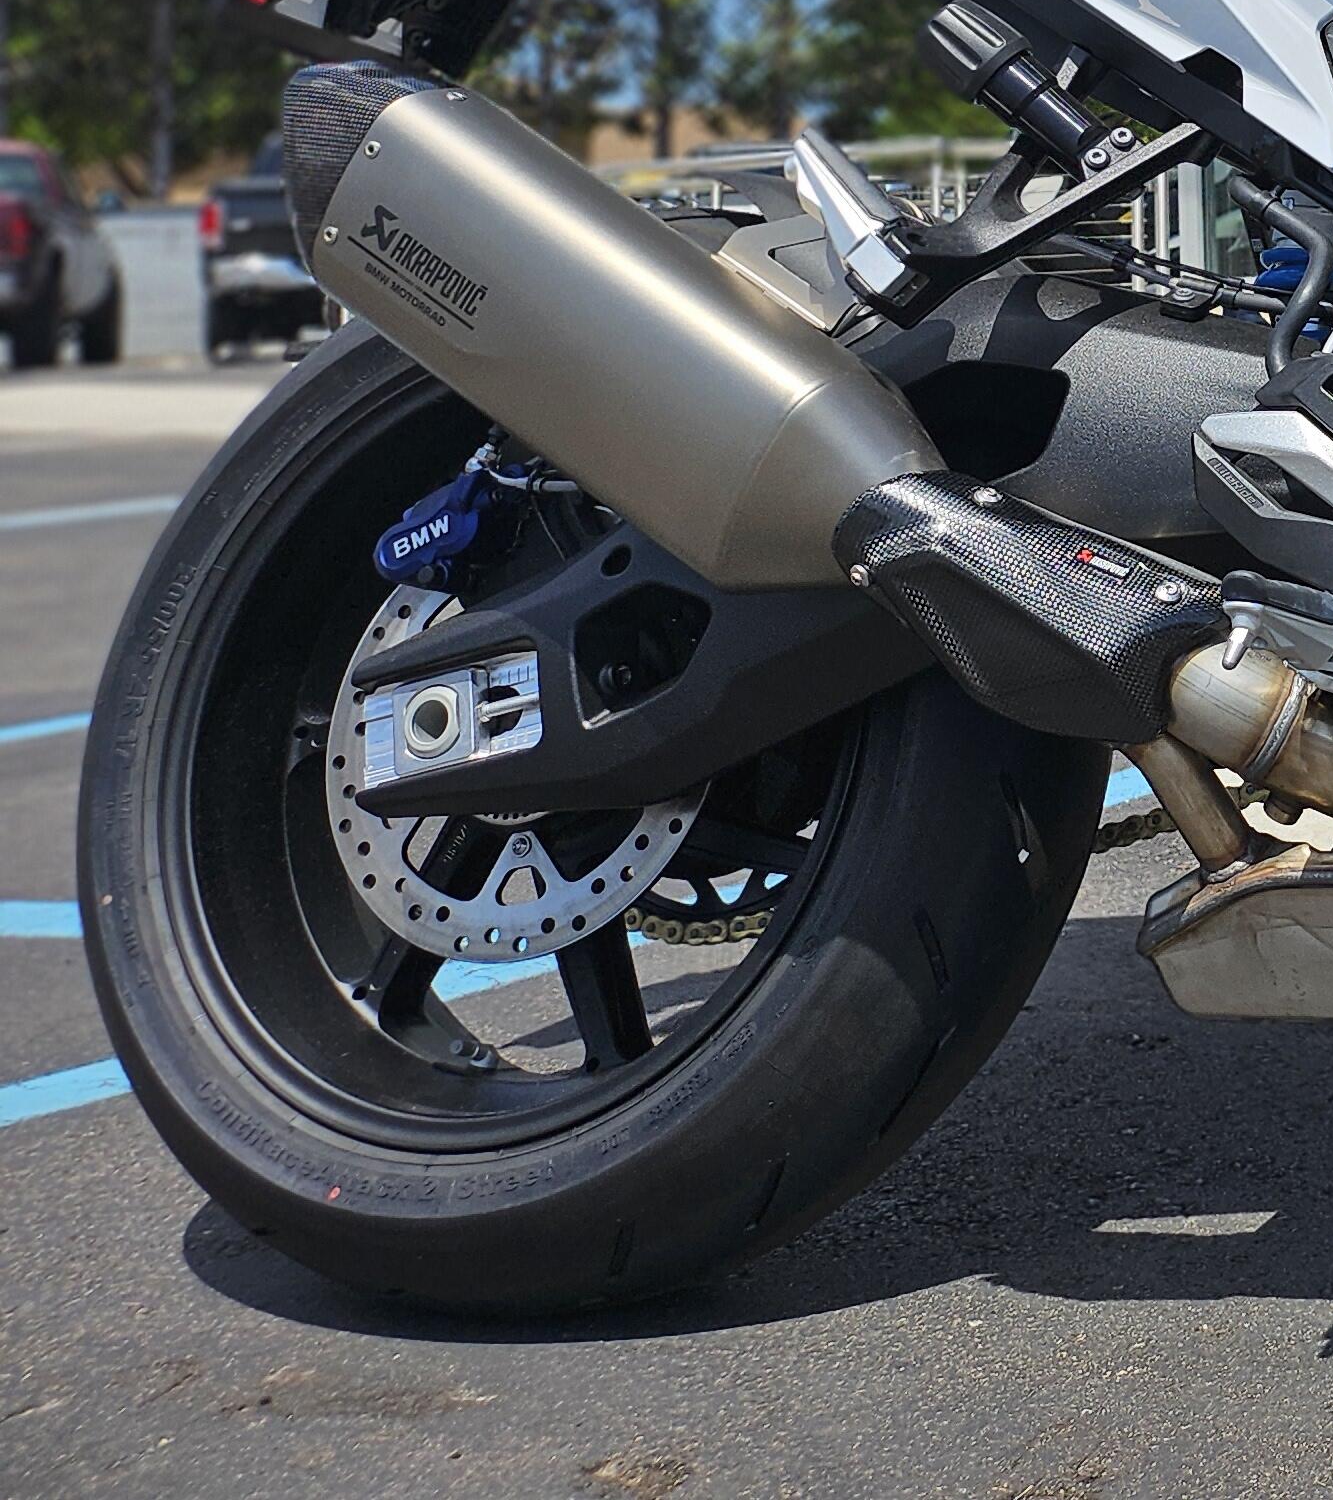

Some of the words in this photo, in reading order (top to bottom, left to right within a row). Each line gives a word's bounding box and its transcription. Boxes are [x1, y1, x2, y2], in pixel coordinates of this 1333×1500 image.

[364, 262, 391, 285] BMW
[390, 281, 447, 327] MOTORRAD
[392, 515, 450, 558] BMW
